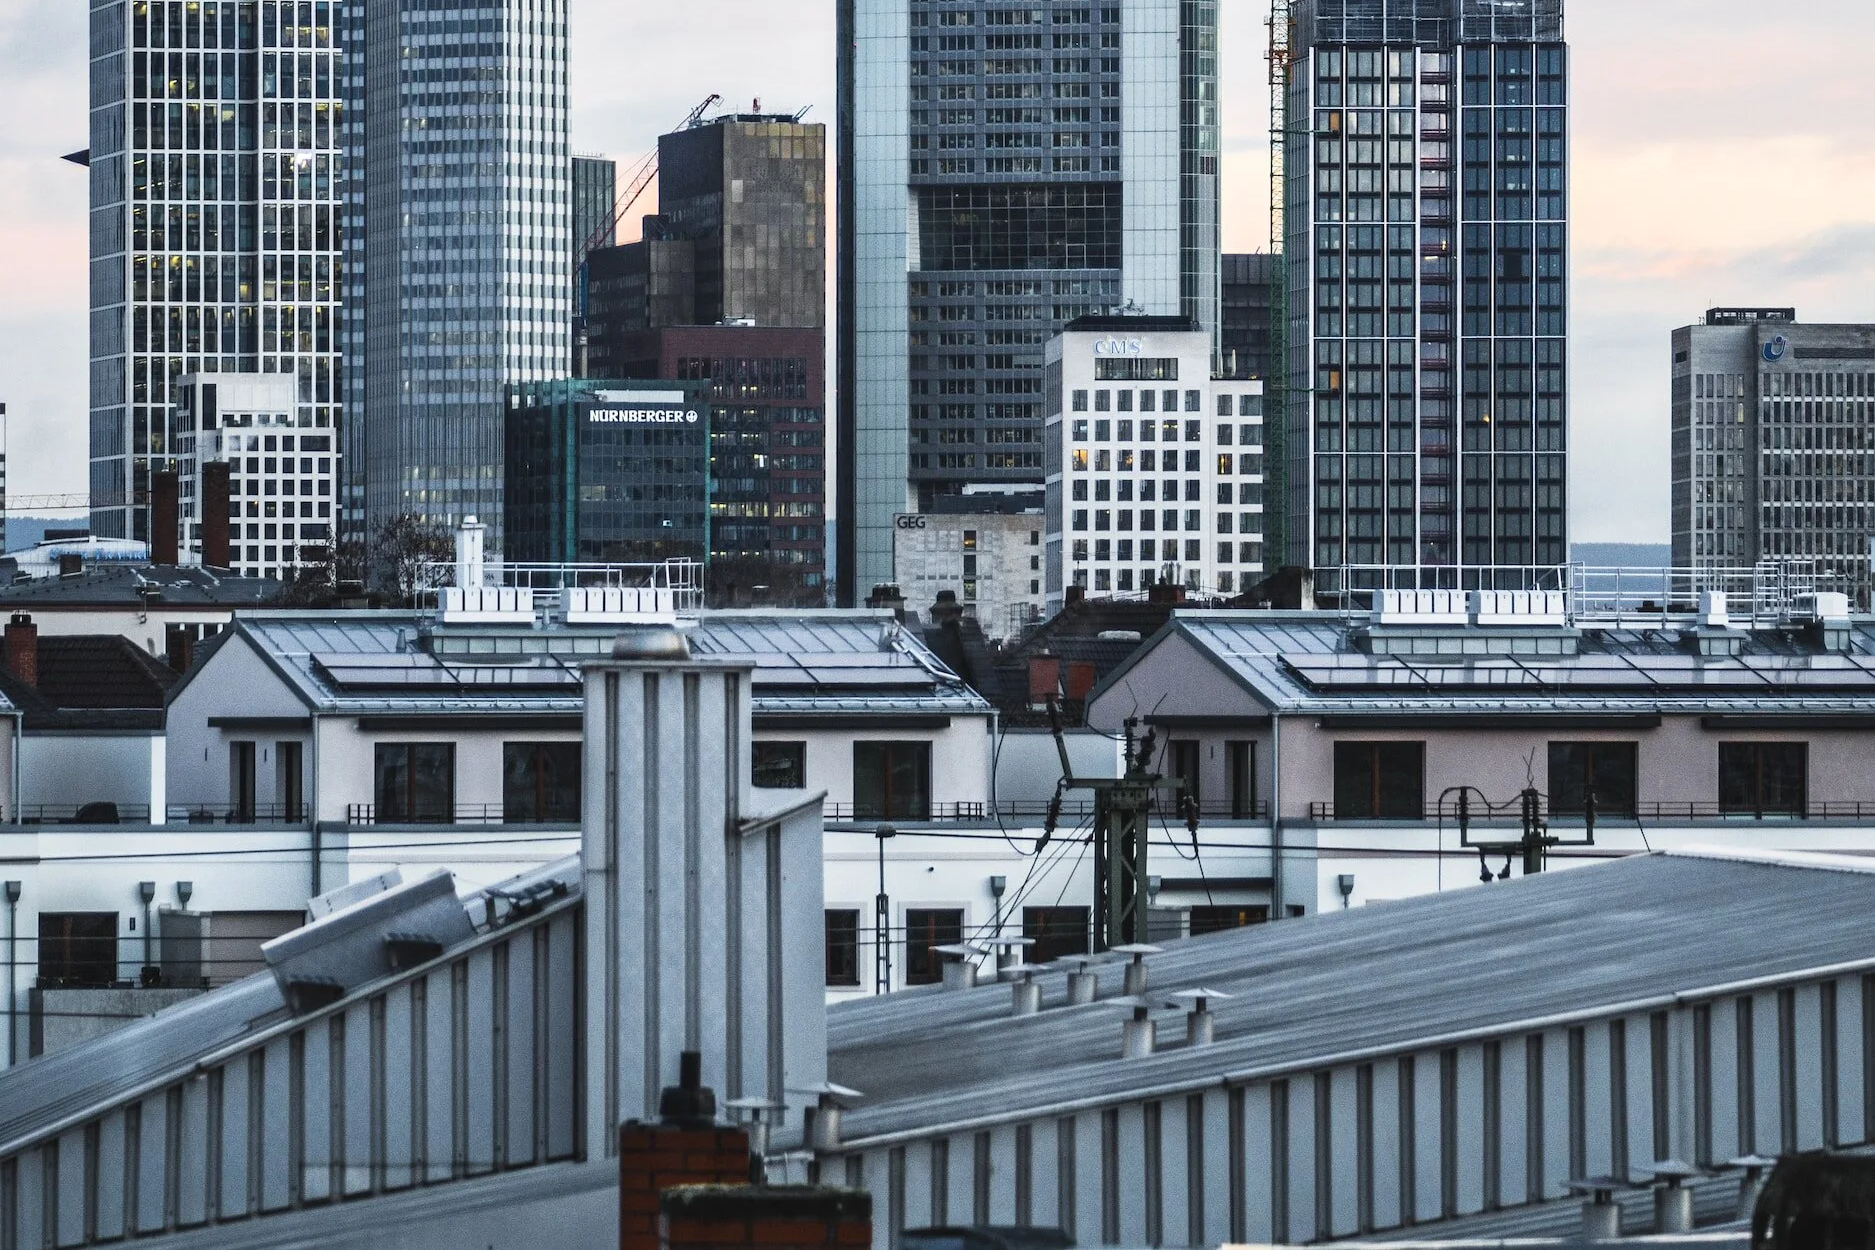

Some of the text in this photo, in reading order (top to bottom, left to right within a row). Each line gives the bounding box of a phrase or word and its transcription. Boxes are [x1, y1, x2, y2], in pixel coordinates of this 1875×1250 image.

[1095, 339, 1140, 355] CMS
[589, 409, 684, 423] NÜRNBERGER
[897, 515, 926, 529] GEG
